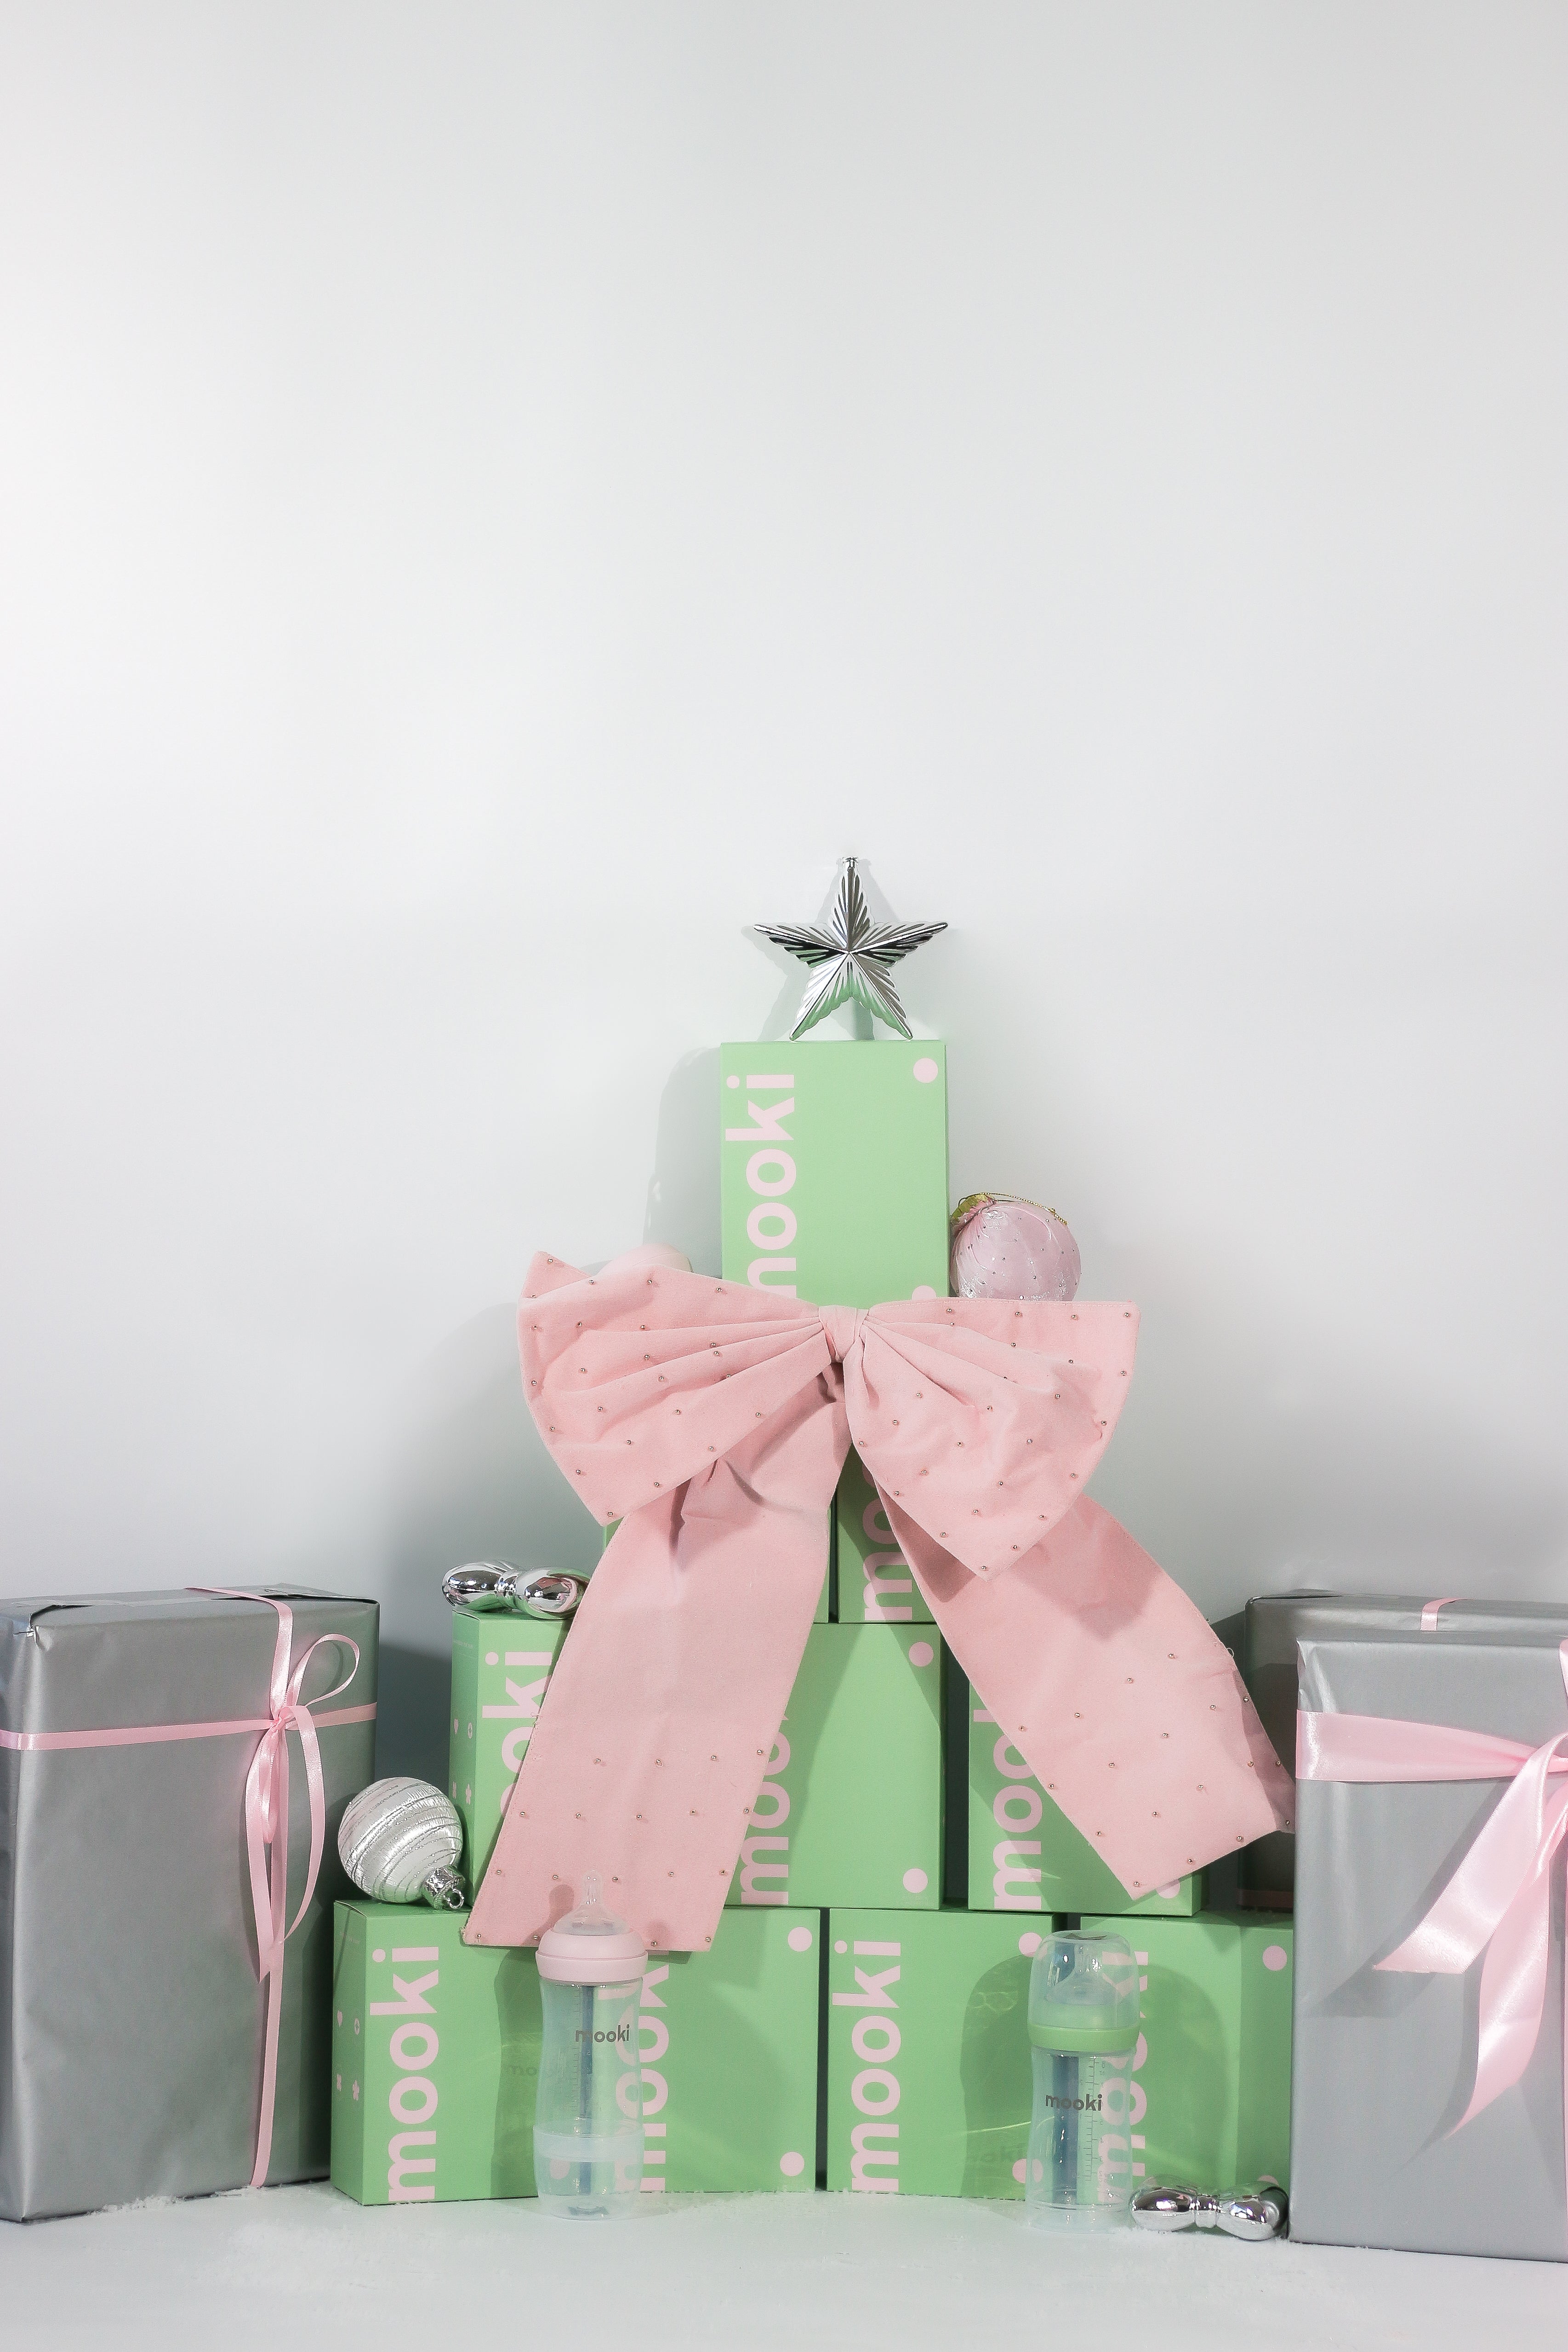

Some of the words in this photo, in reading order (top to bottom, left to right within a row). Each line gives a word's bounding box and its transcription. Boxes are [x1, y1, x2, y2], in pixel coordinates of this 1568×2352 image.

[973, 1709, 1043, 1910] moo
[370, 1946, 439, 2202] mooki
[575, 2024, 630, 2043] mooki
[832, 1940, 901, 2192] mooki
[1045, 2093, 1103, 2112] mooki
